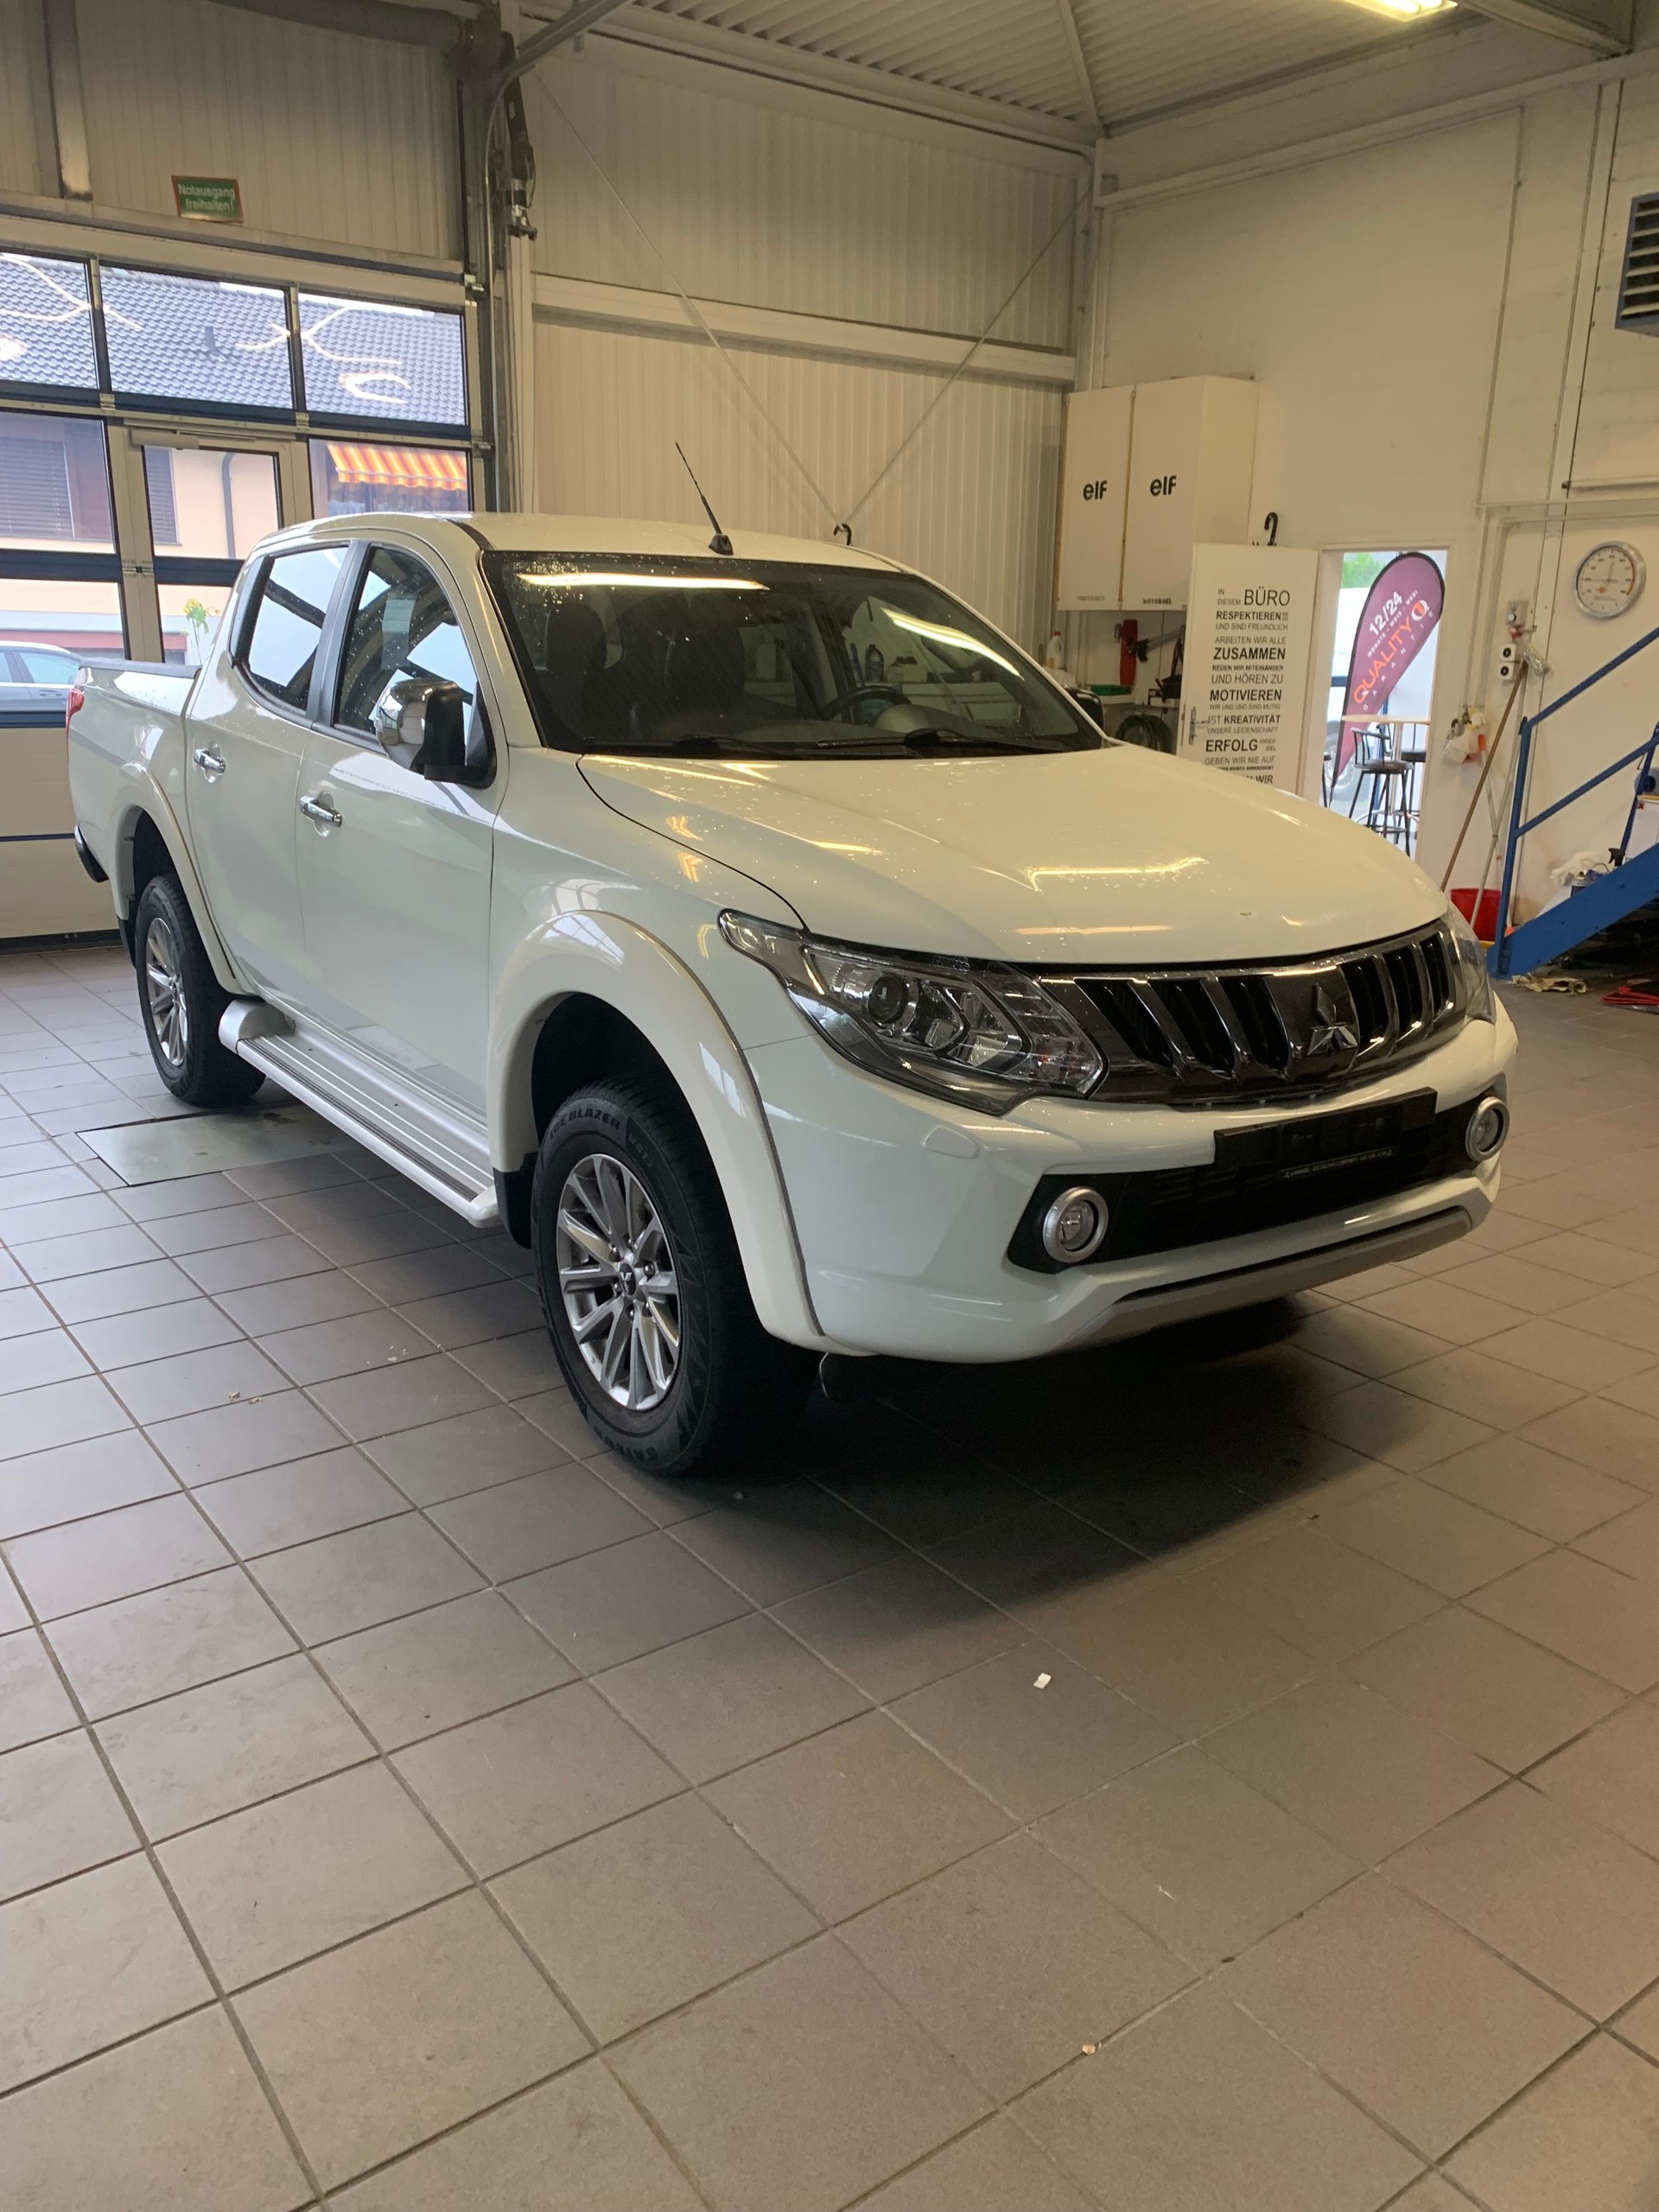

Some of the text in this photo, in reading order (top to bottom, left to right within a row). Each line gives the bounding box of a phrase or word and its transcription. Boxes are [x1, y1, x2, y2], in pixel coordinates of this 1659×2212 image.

[177, 183, 236, 200] Notausgang
[1083, 480, 1108, 501] elf
[1149, 474, 1177, 497] elf
[1243, 586, 1291, 607] BÜRO
[1216, 610, 1281, 621] RESPEKTIEREN
[1369, 590, 1403, 636] 12/24
[1215, 622, 1230, 631] UND
[1230, 622, 1246, 631] SIND
[1214, 635, 1287, 645] ARBEITEN WIR ALLE
[1367, 633, 1387, 658] MONATE
[1213, 646, 1286, 660] ZUSAMMEN
[1211, 673, 1284, 684] UND HÖREN ZU
[1210, 689, 1282, 702] MOTIVIEREN
[1208, 714, 1281, 724] IST KREATIVITÄT
[1233, 726, 1279, 734] LEIDENSCHAFT
[1205, 738, 1258, 753] ERFOLG
[1205, 757, 1230, 766] GEBEN
[1260, 755, 1276, 764] AUF
[569, 1108, 621, 1129] BLAZER
